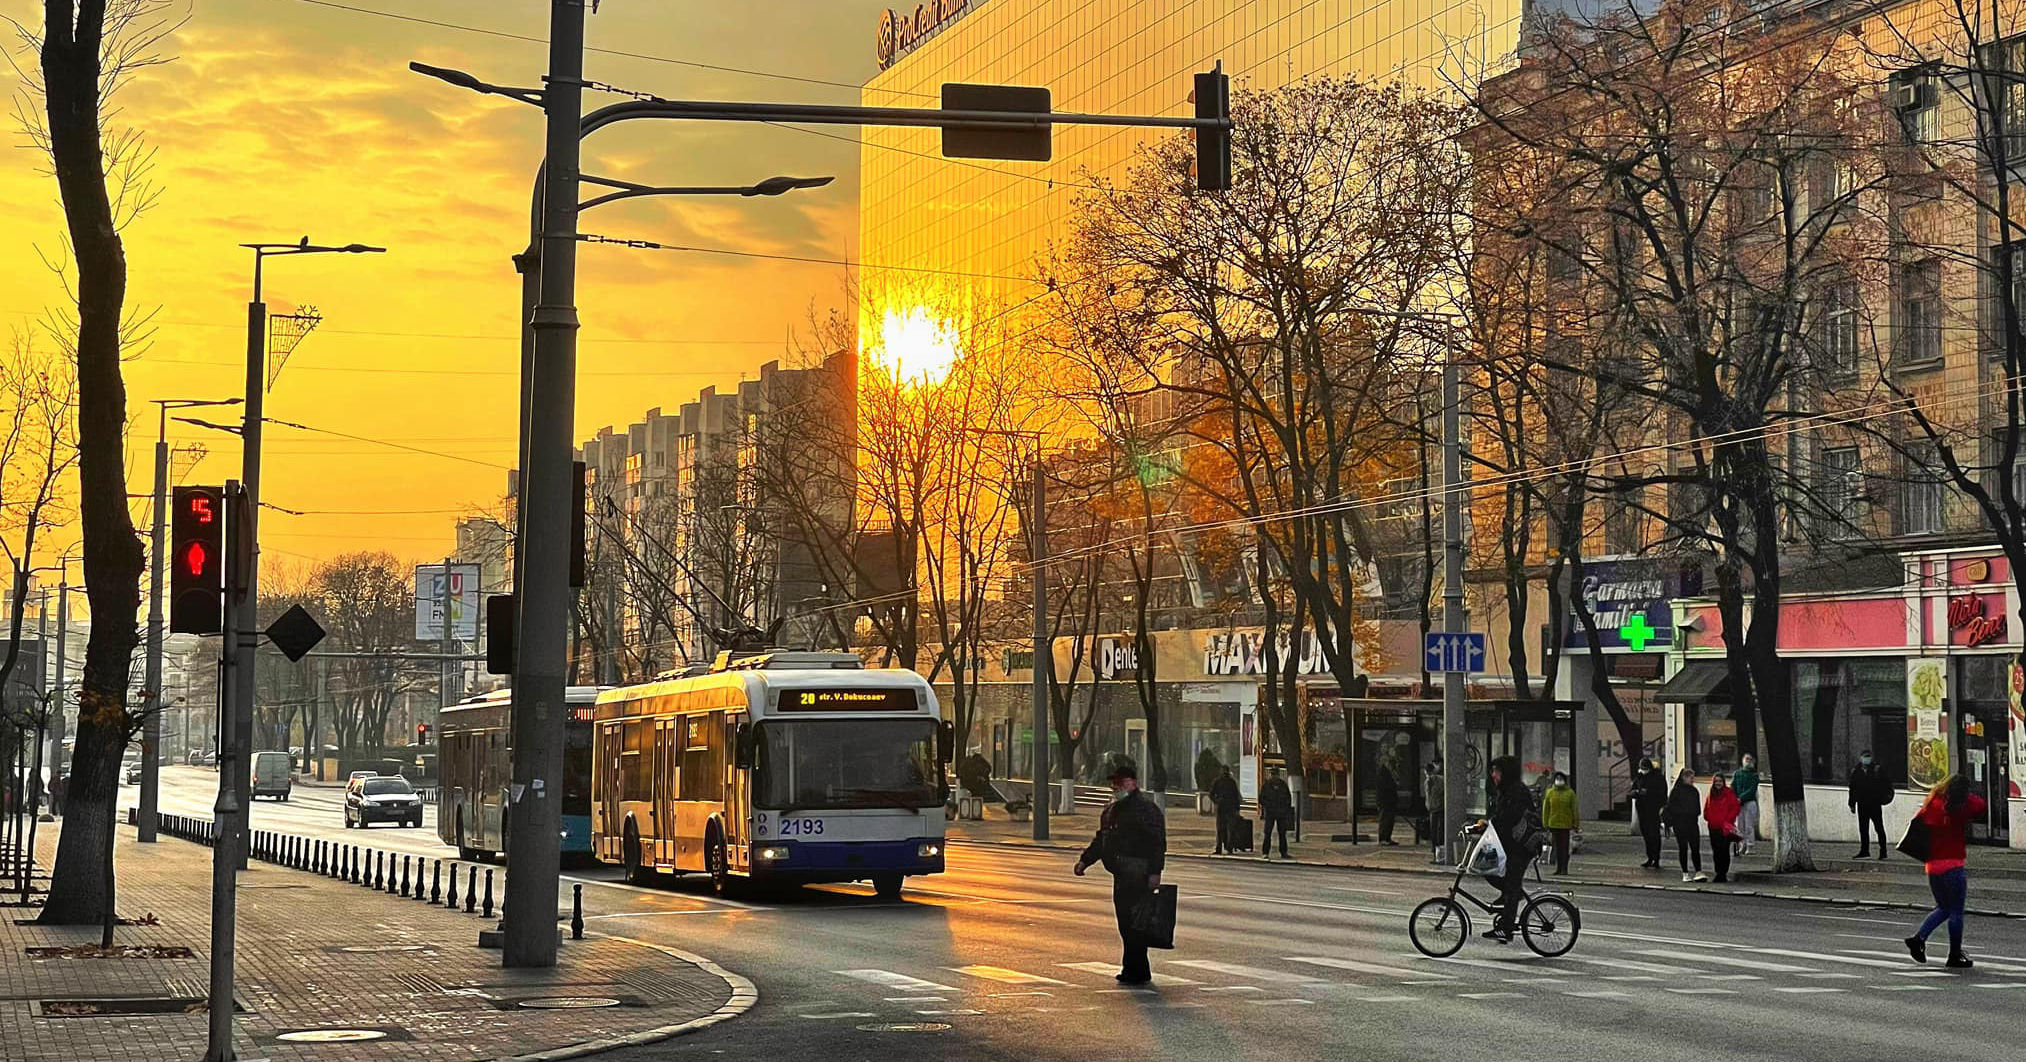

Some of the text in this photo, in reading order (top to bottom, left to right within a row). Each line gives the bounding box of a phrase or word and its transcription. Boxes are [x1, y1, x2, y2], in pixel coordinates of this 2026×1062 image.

[192, 499, 212, 522] 15
[801, 692, 815, 705] 20
[780, 819, 824, 835] 2193
